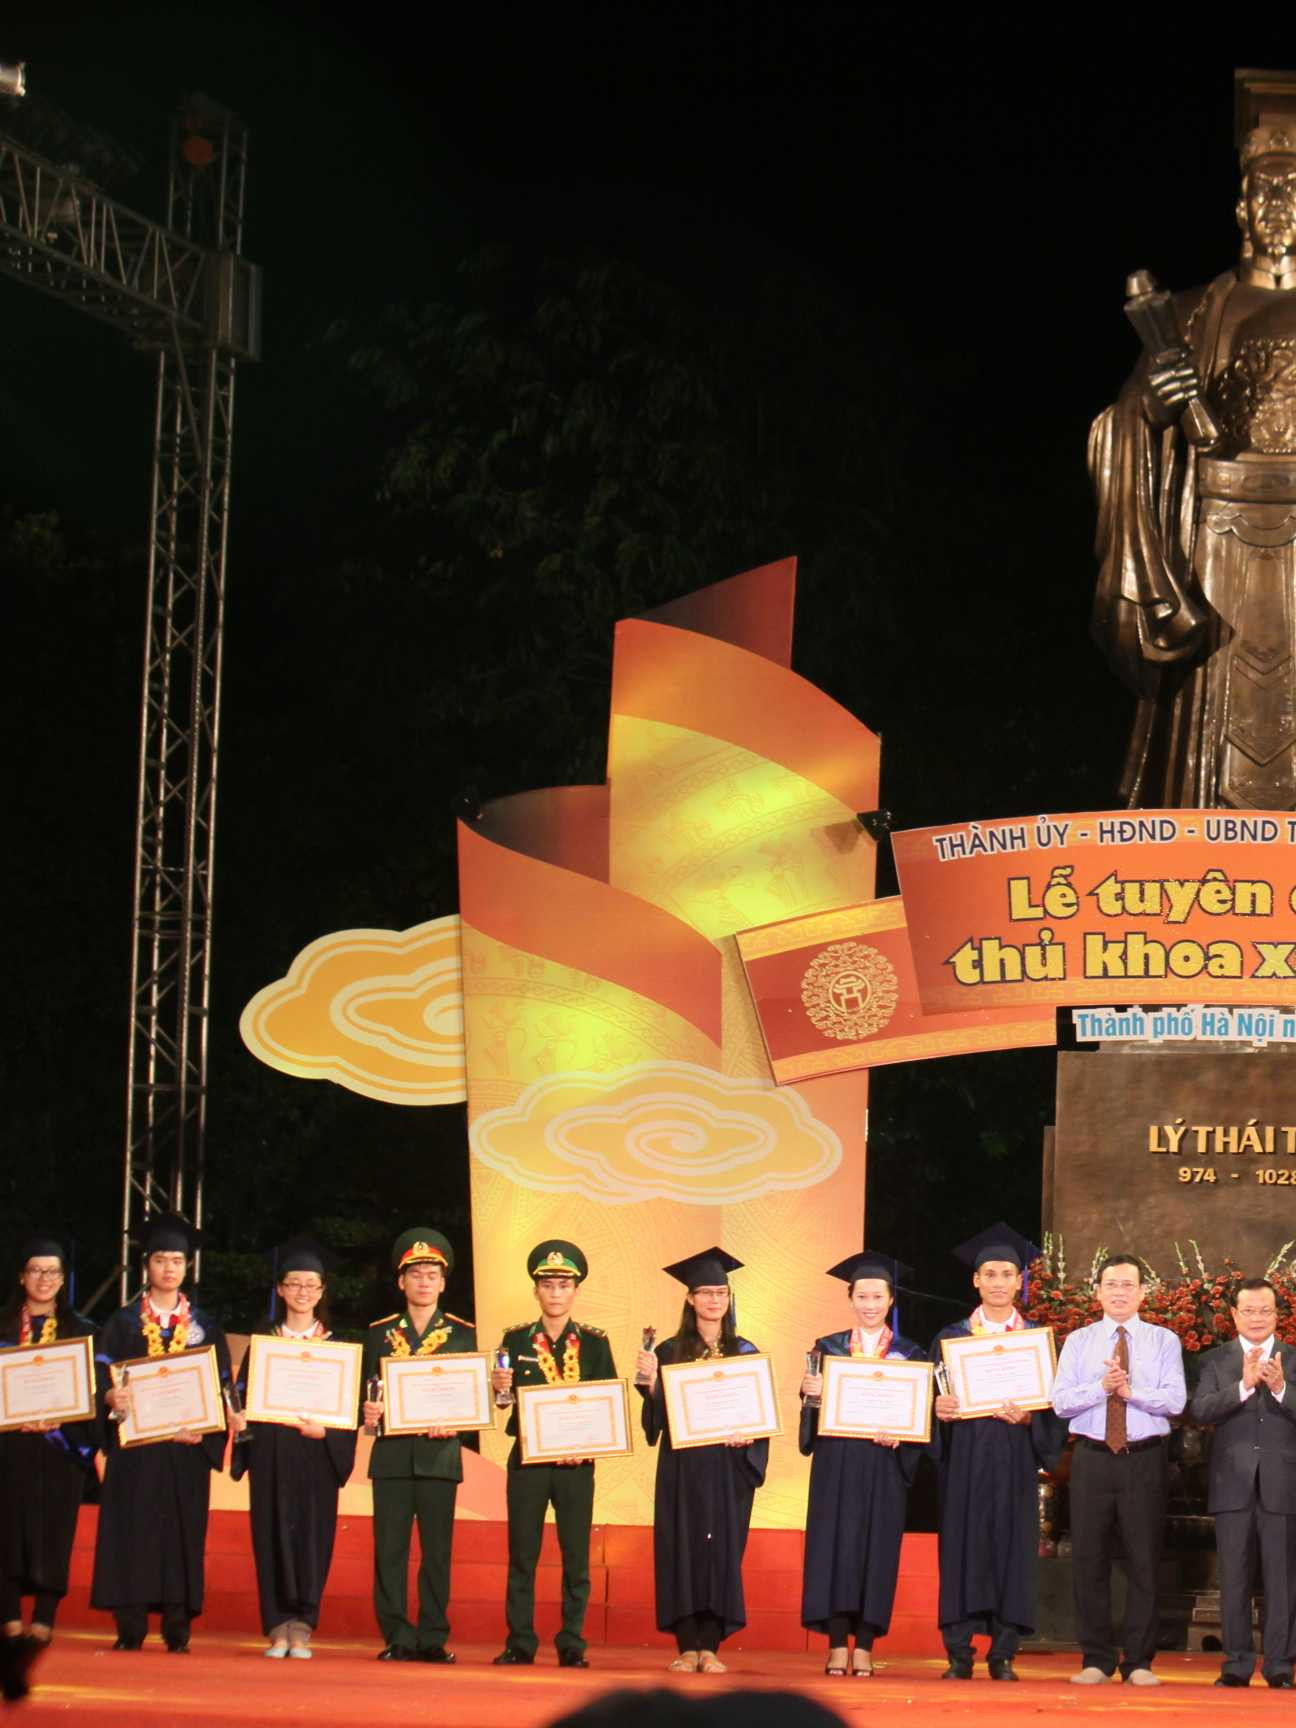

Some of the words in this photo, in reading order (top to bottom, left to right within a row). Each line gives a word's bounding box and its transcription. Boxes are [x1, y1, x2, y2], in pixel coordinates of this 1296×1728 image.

[934, 824, 1026, 860] THÀNH
[1035, 816, 1069, 847] ỦY
[1099, 819, 1176, 843] HĐND
[1206, 819, 1278, 842] UBND
[1008, 865, 1080, 922] Lễ
[1087, 868, 1274, 924] tuyên
[944, 928, 1067, 986] thủ
[1083, 932, 1243, 979] khoa
[1077, 1010, 1145, 1038] Thành
[1152, 1008, 1195, 1039] phố
[1201, 1011, 1230, 1037] Hà
[1237, 1011, 1275, 1043] Nội
[1149, 1118, 1187, 1154] LÝ
[1191, 1119, 1275, 1154] THÁI
[1178, 1166, 1217, 1184] 974
